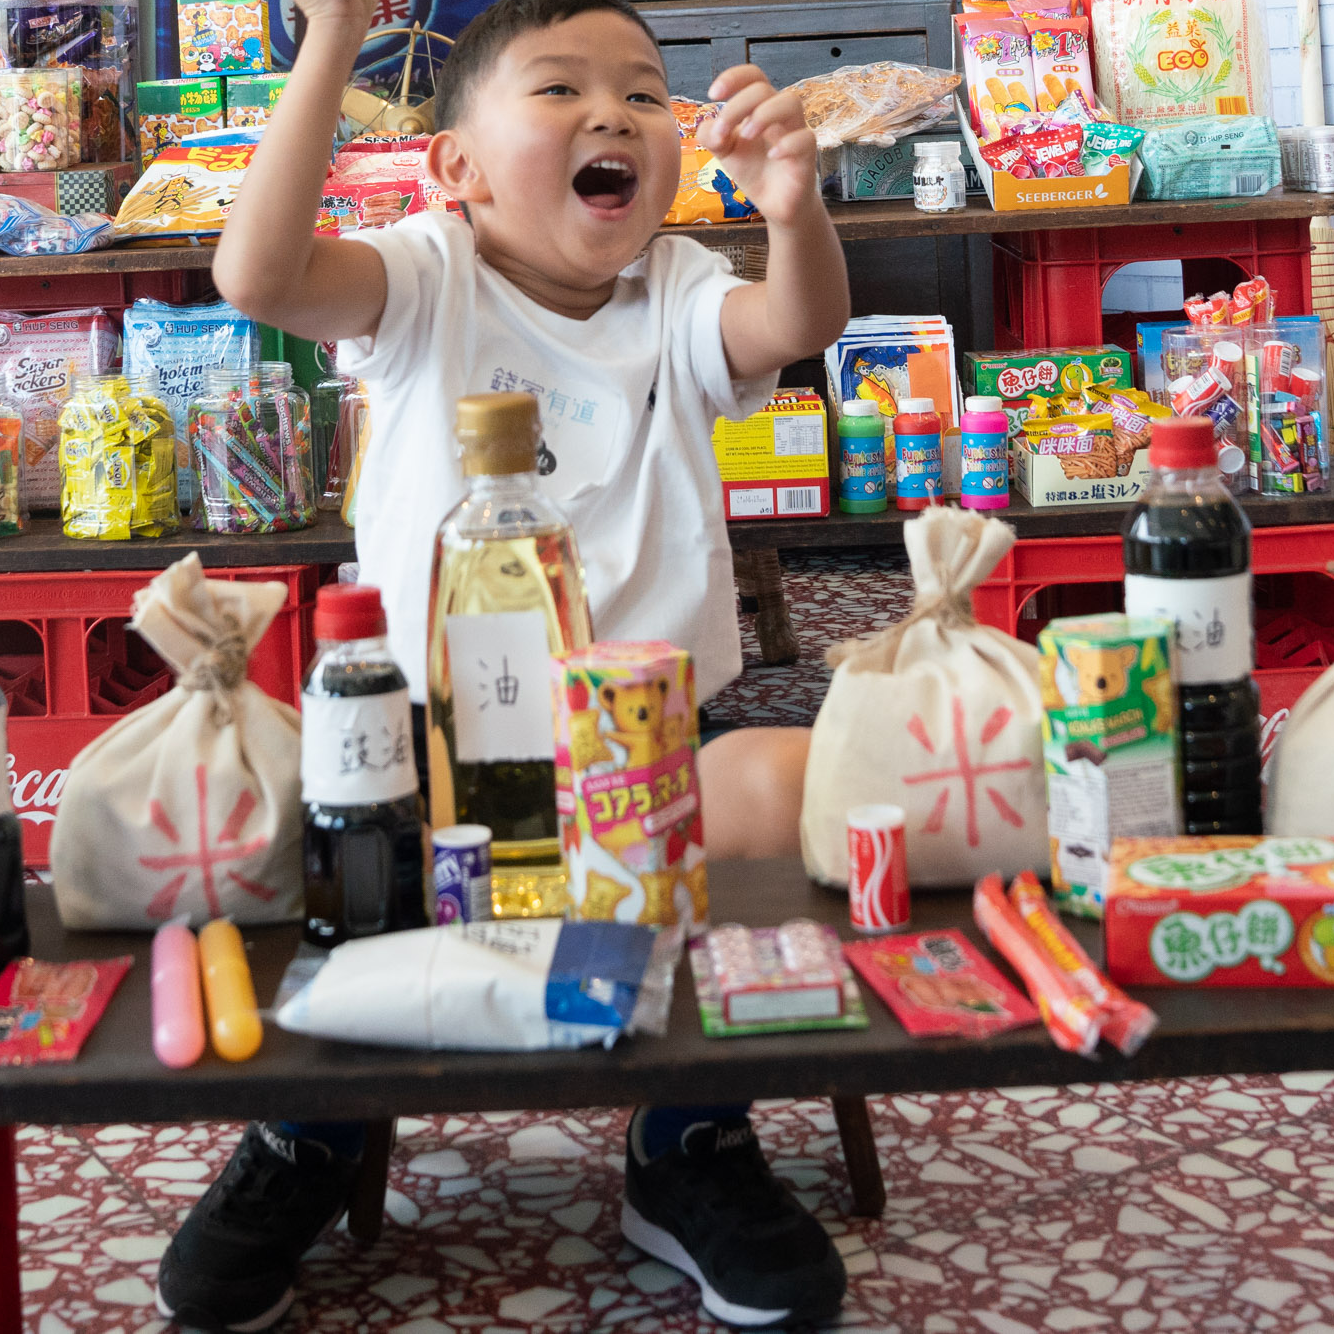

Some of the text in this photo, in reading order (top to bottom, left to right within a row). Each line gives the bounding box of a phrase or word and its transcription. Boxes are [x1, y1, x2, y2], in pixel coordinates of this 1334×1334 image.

[1157, 49, 1209, 71] EGO
[1086, 136, 1133, 149] JEWEL RING
[1206, 131, 1245, 144] HUP SENG
[1034, 139, 1079, 164] JEWEL RING
[862, 147, 904, 189] JACOB
[320, 195, 357, 209] 焼さん
[1016, 190, 1094, 204] SEEBERGER
[24, 320, 79, 332] HUP SENG
[176, 324, 198, 334] HUP
[17, 357, 65, 378] Sugar
[12, 372, 66, 394] ackers
[999, 361, 1056, 397] 魚仔餅
[278, 399, 292, 447] Sochews
[1091, 400, 1147, 433] 咪咪面
[1039, 435, 1094, 455] 咪咪面
[1045, 481, 1140, 502] 特濃8.2 塩ミルク
[477, 654, 520, 710] 油
[902, 695, 1033, 848] 米
[138, 763, 280, 923] 米
[1161, 910, 1281, 972] 魚仔餅
